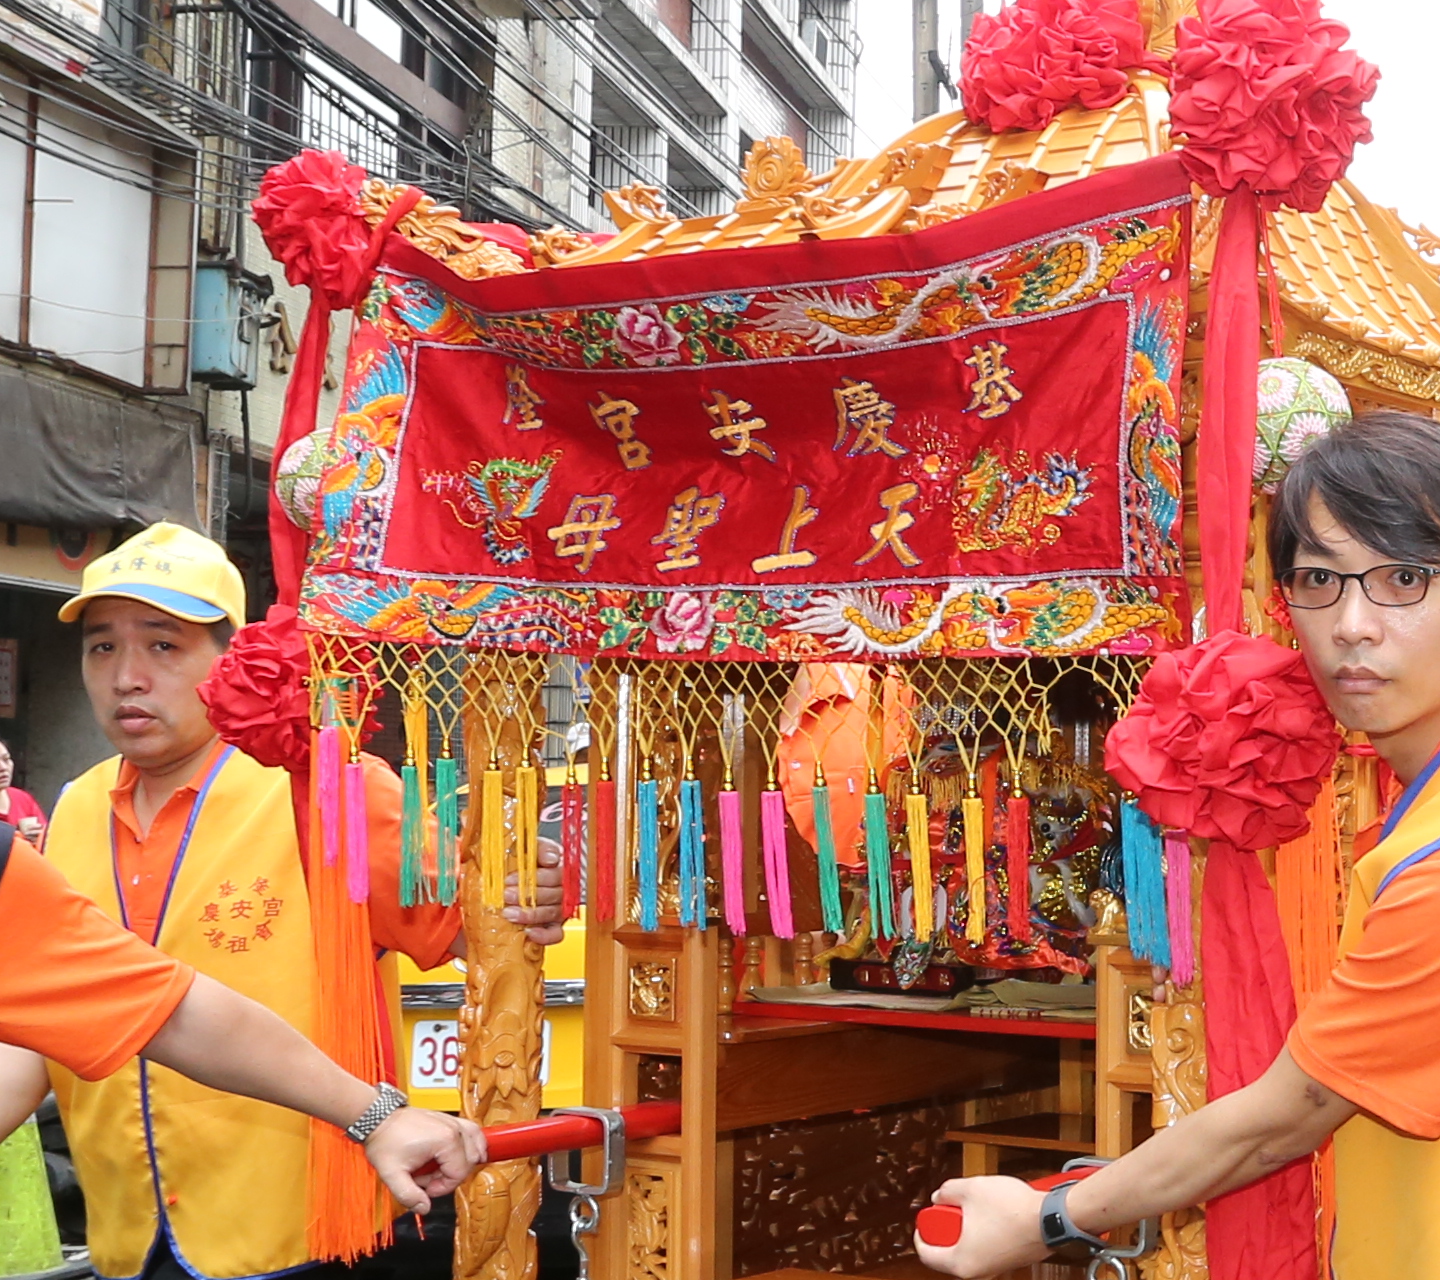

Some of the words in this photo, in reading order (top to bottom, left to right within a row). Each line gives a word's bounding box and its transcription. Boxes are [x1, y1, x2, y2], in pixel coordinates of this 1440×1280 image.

[546, 482, 924, 576] 天上聖母
[197, 896, 285, 922] 慶安宮
